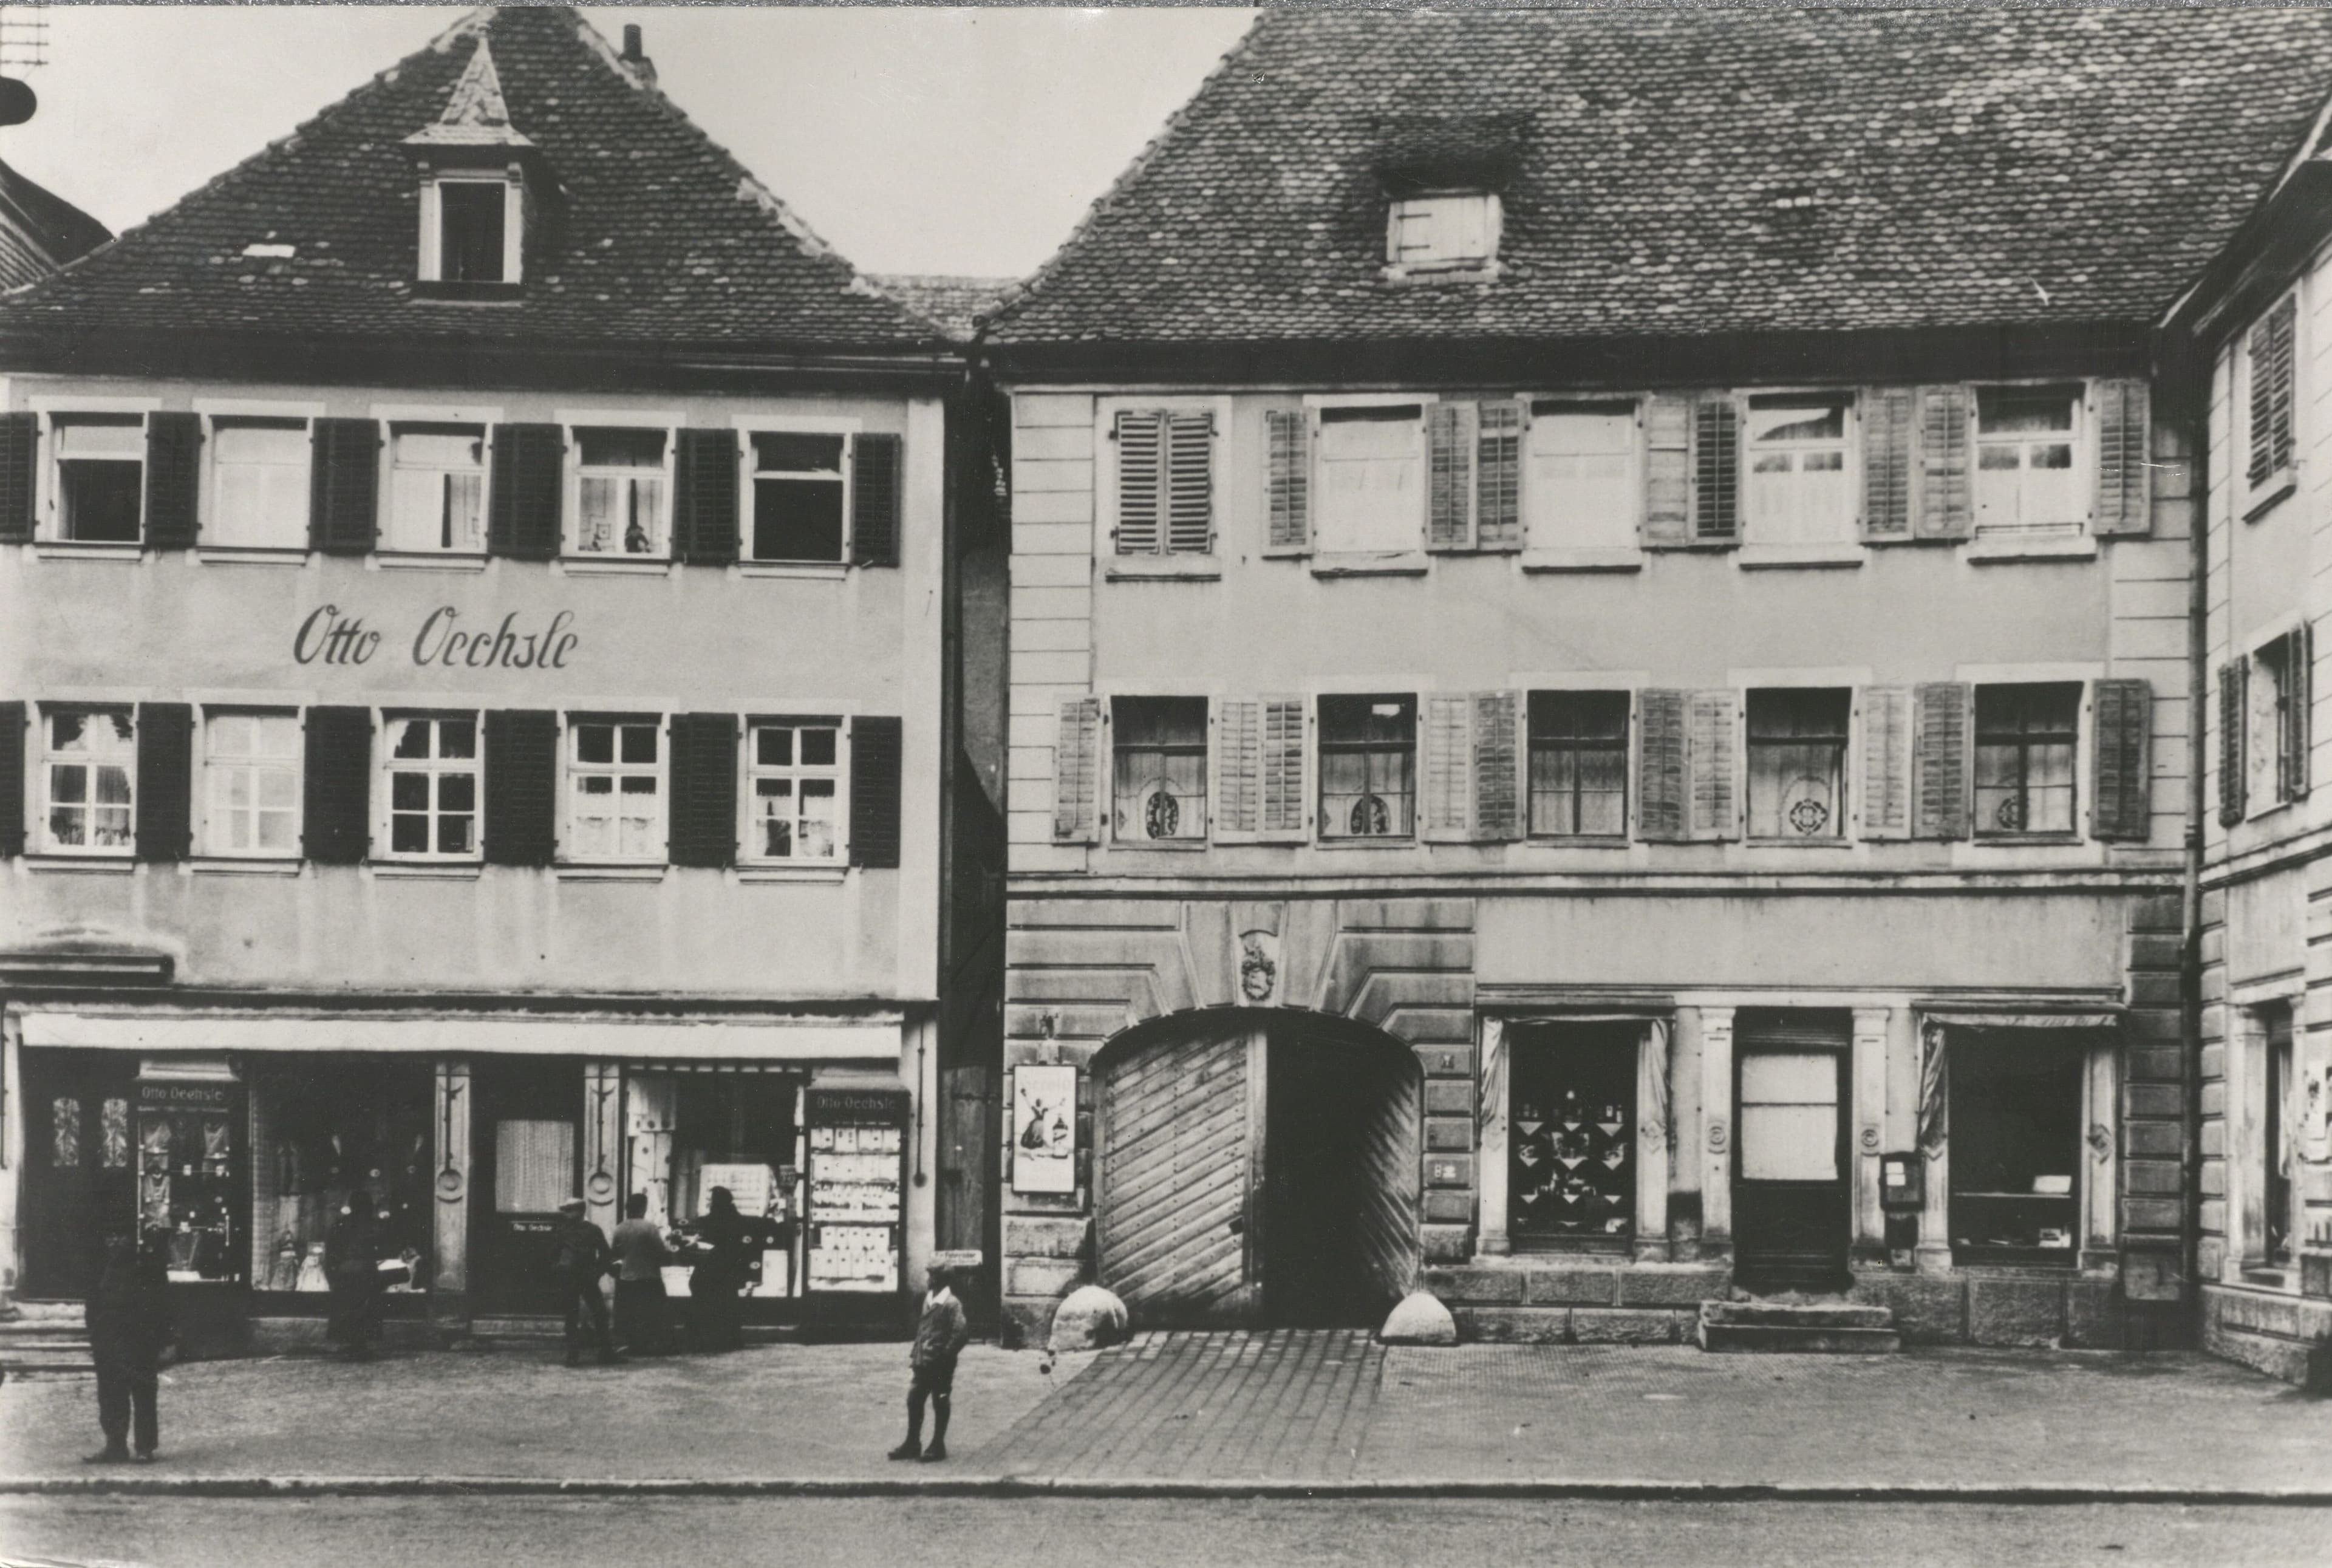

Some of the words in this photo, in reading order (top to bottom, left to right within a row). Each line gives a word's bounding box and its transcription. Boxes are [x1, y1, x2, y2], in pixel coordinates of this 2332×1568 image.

[294, 604, 380, 666] Otto
[411, 605, 579, 669] Oechsle
[141, 1086, 166, 1099] Otto
[170, 1086, 223, 1100] Oechsle
[816, 1094, 841, 1109] Otto
[845, 1096, 895, 1110] Oechsle
